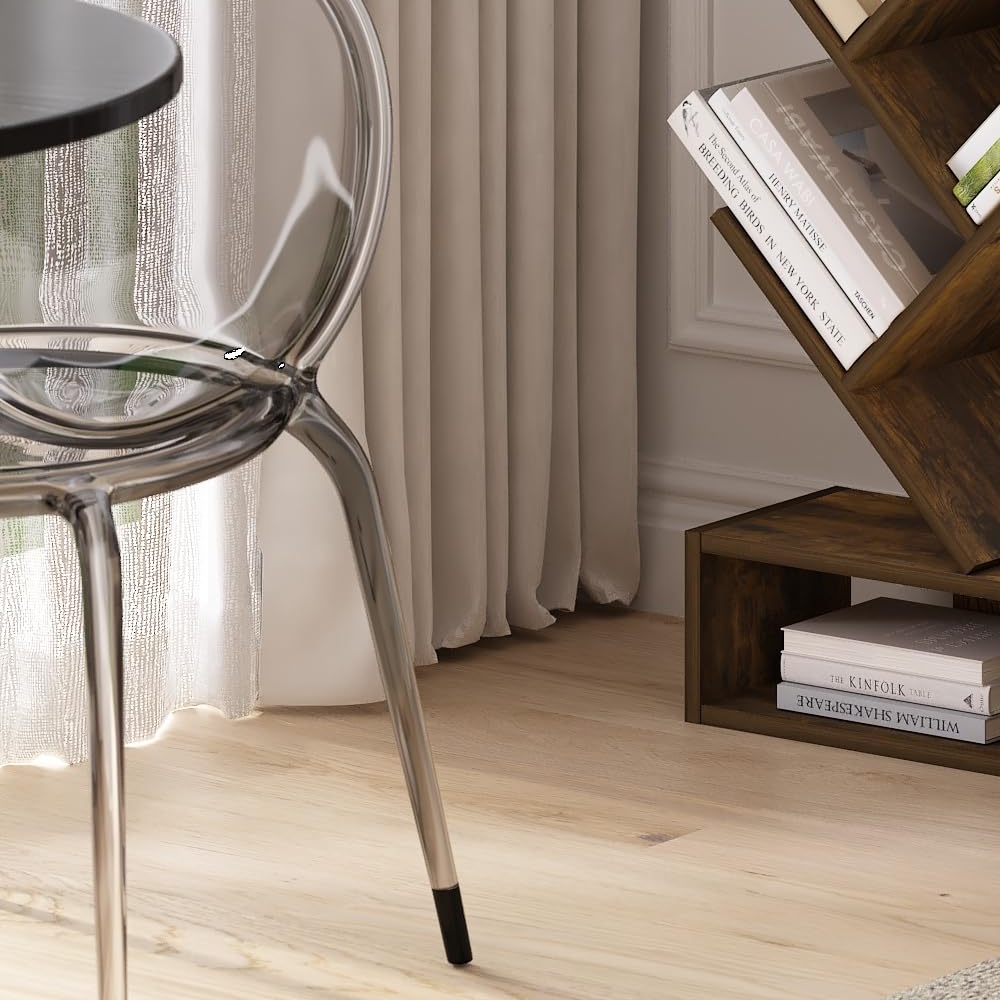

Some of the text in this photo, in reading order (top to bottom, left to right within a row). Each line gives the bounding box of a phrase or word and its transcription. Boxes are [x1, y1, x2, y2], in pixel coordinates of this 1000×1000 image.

[750, 118, 782, 161] CASA
[708, 133, 720, 148] The
[720, 147, 739, 176] Second
[738, 174, 752, 194] Atlas
[750, 192, 760, 203] of
[768, 172, 827, 250] HENRY MATISSE
[698, 142, 740, 199] BREEDING
[739, 199, 765, 234] BIRDS
[765, 234, 776, 250] IN
[777, 251, 798, 278] NEW
[796, 276, 820, 311] YORK
[820, 312, 846, 346] STATE
[854, 290, 876, 319] TASCHEN
[830, 675, 933, 699] THE KINFOLK TABLE
[796, 694, 960, 734] WILLIAM SHAKESPEARE
